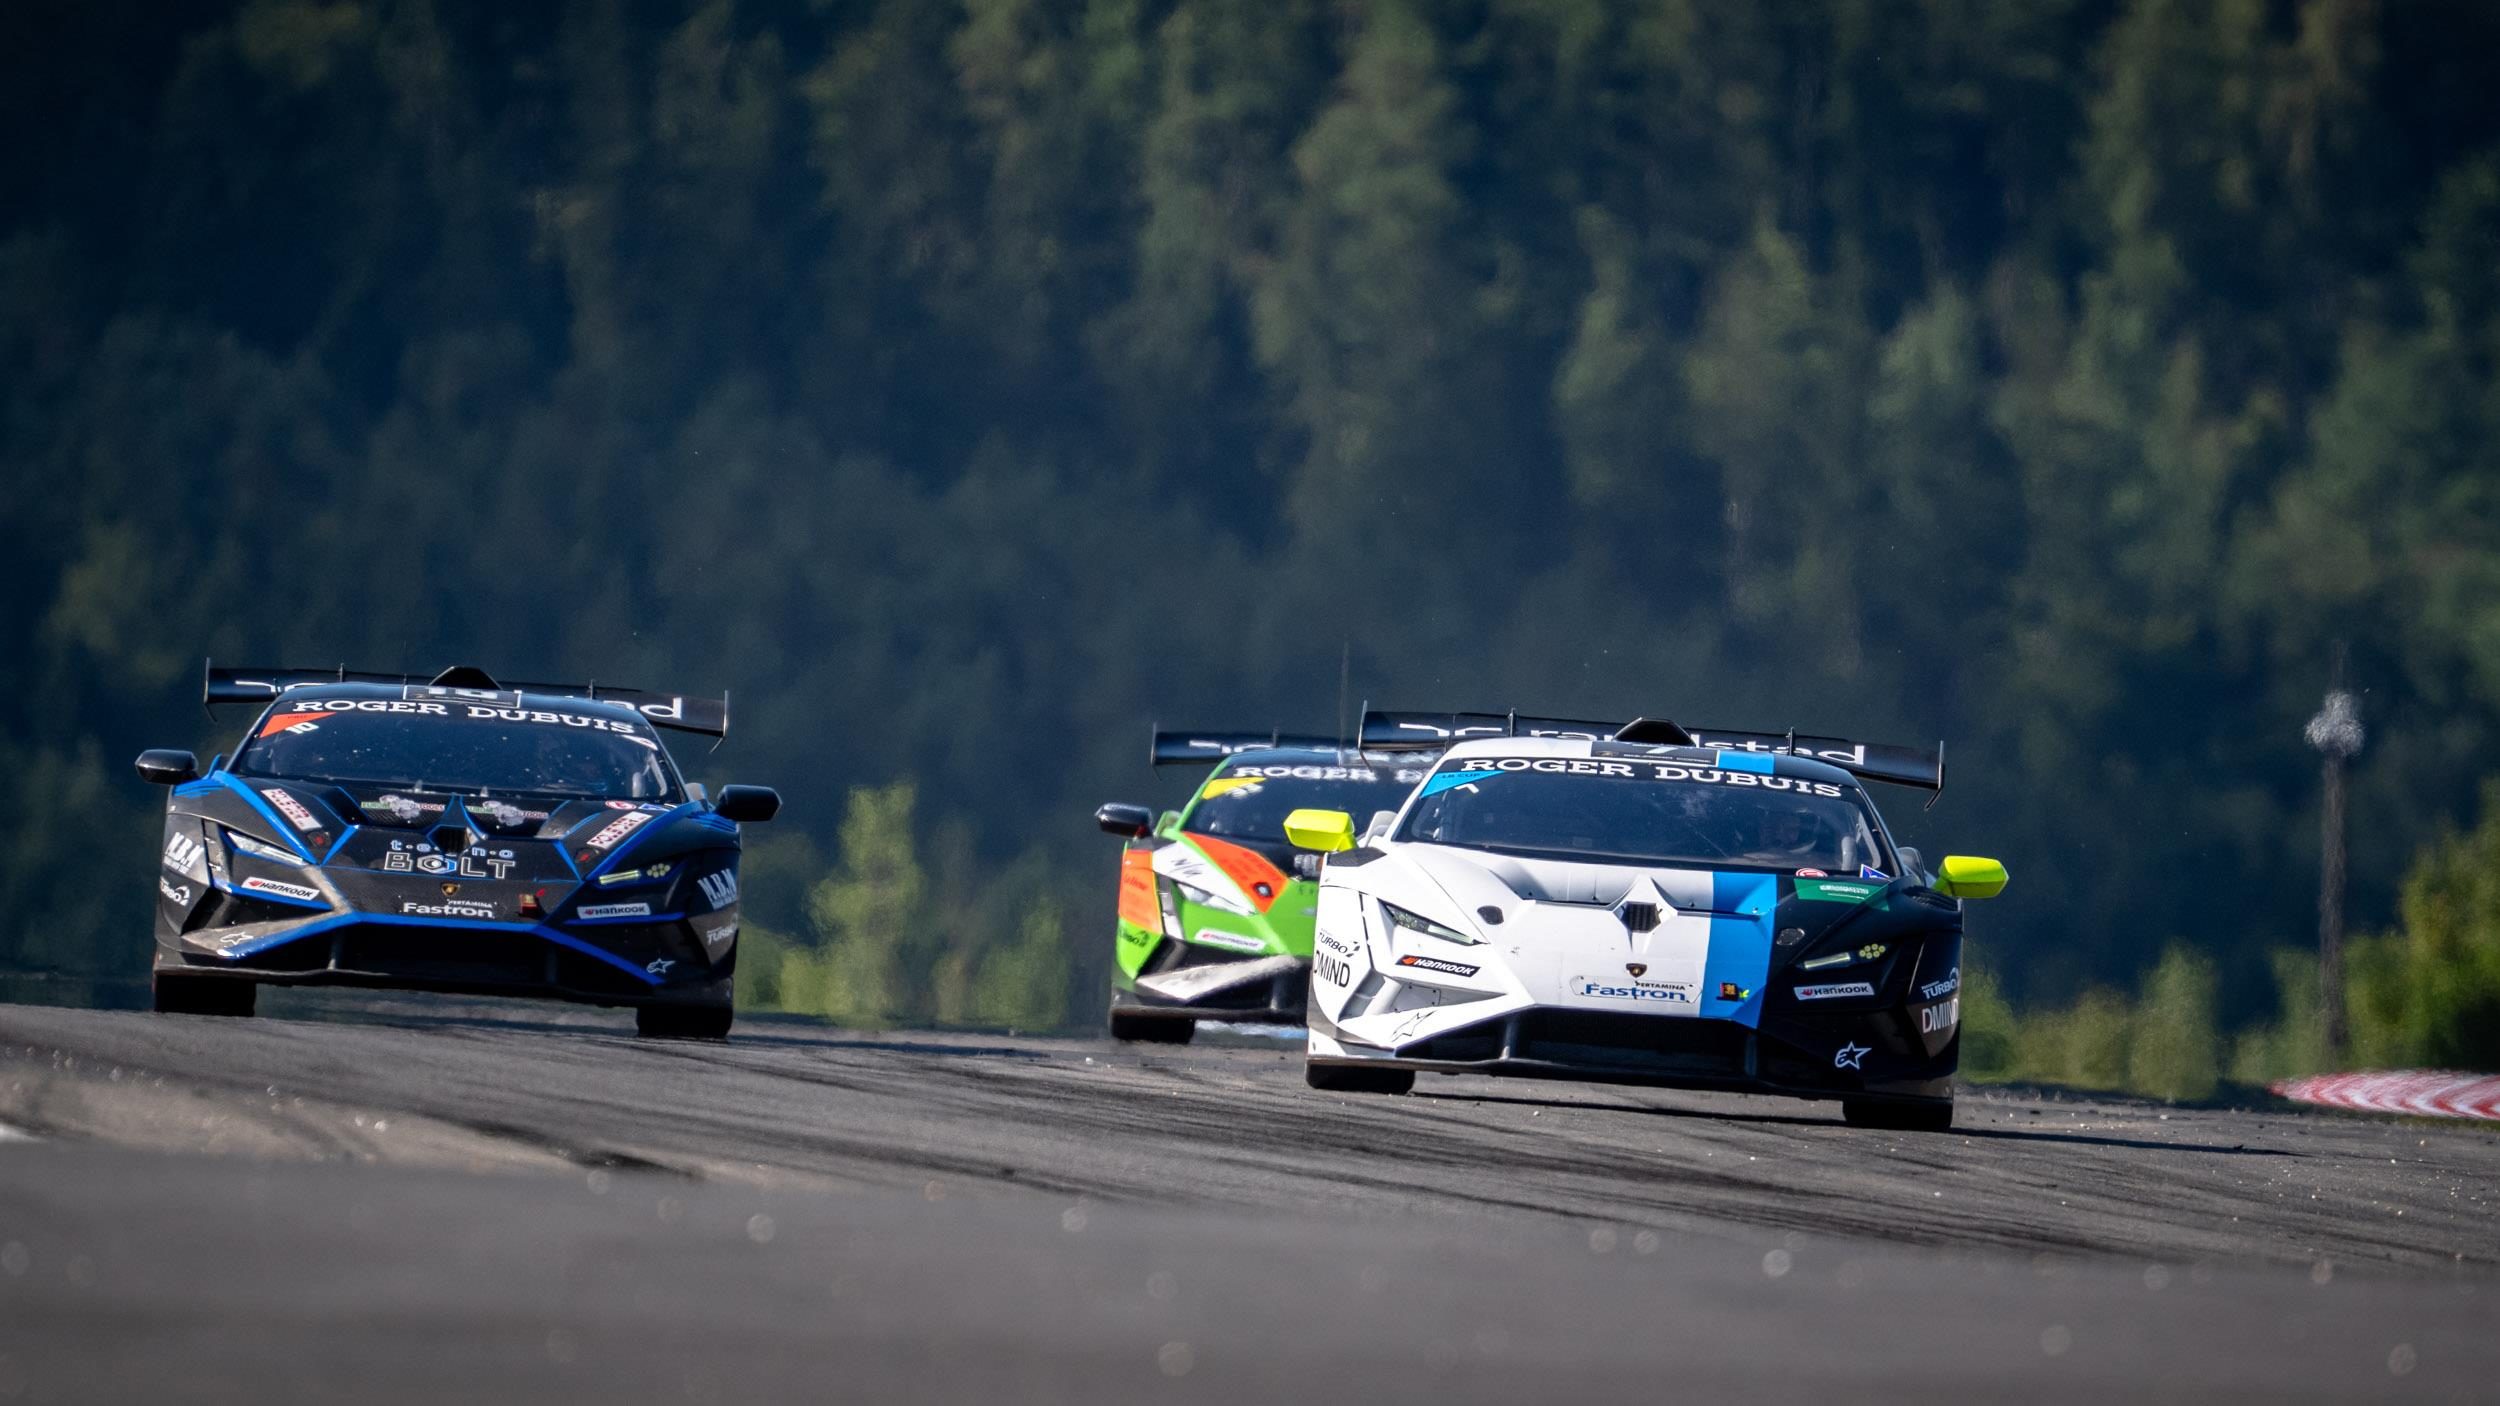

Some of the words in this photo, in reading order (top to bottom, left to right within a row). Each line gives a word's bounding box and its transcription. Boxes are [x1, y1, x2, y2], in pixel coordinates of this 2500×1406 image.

[293, 700, 448, 716] ROGER
[468, 706, 635, 734] DUBUIS
[1233, 765, 1378, 782] ROGER
[1461, 759, 1635, 777] ROGER
[1655, 767, 1842, 797] DUBUIS
[384, 851, 516, 880] BOLT
[403, 902, 495, 919] Fastron
[1586, 983, 1686, 1001] Fastron
[1635, 981, 1686, 991] PERTAMINA
[1923, 979, 1957, 1000] TURBO
